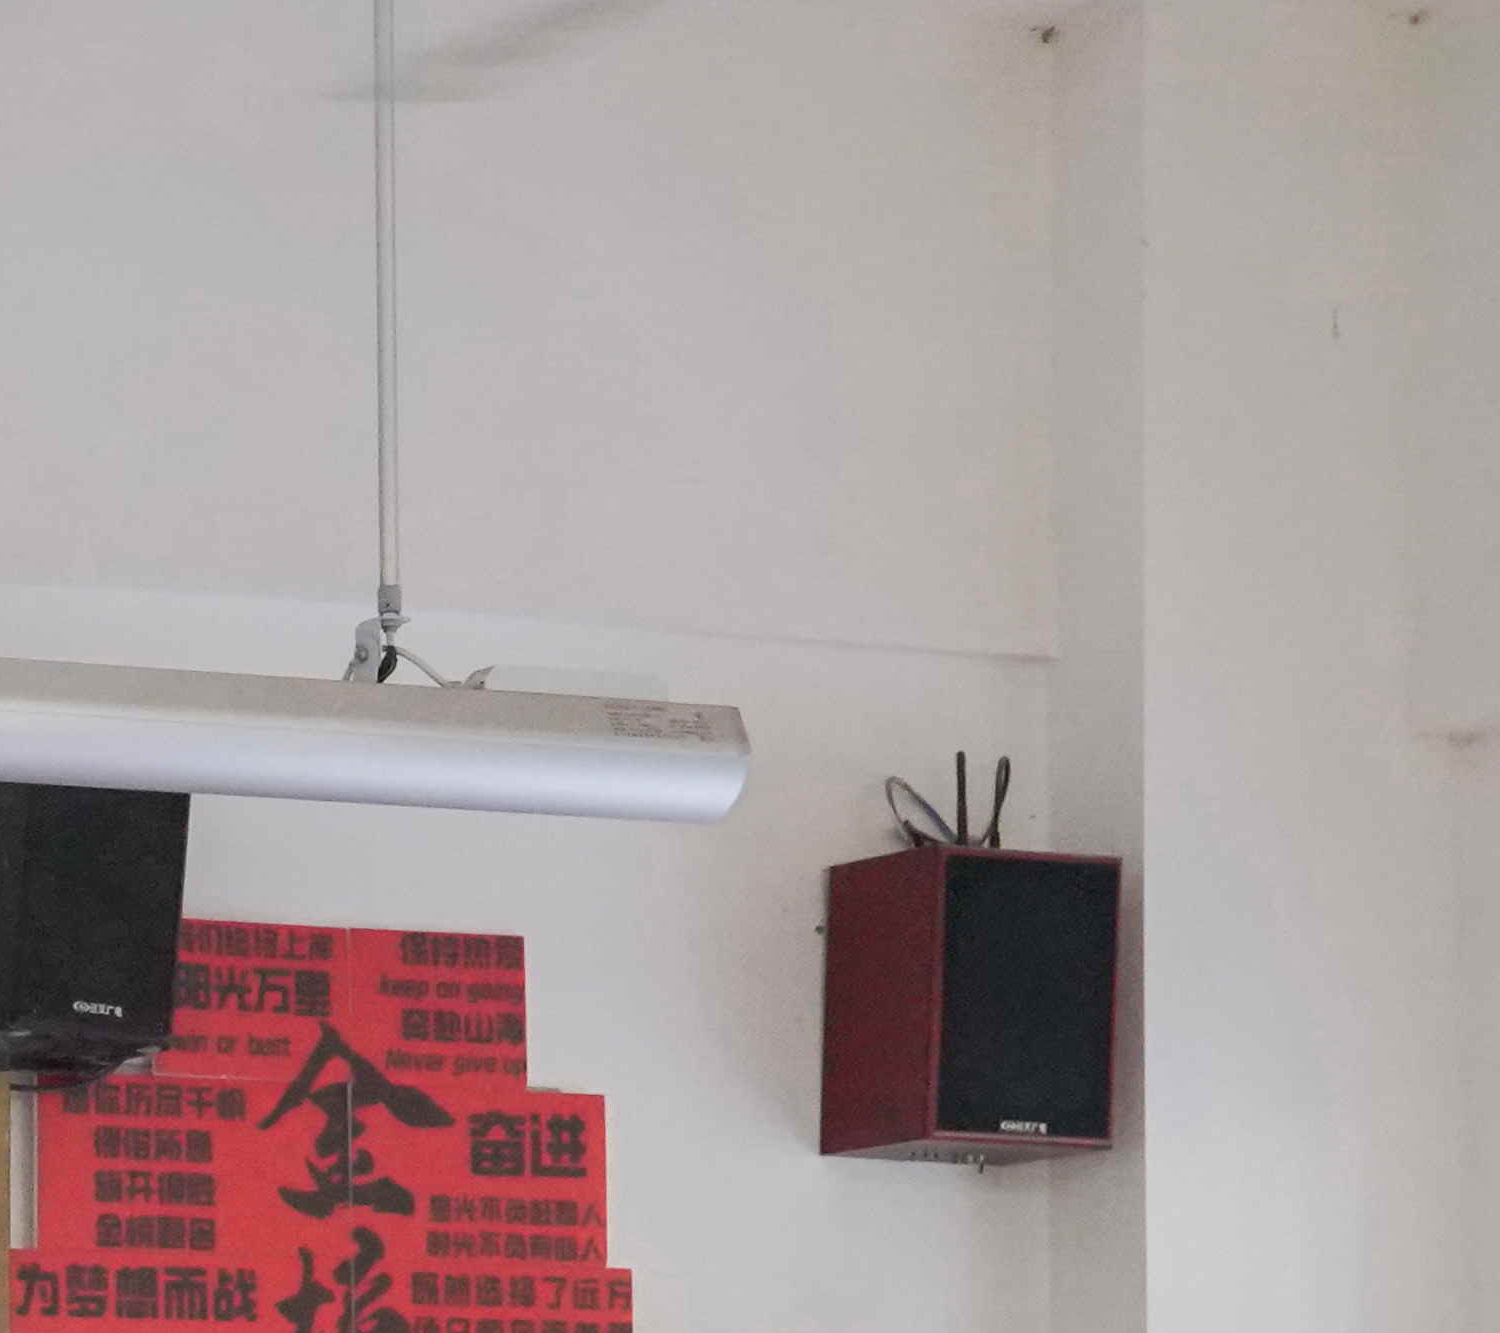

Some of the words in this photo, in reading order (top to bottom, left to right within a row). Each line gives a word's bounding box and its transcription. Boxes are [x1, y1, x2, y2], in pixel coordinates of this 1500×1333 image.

[467, 1110, 587, 1177] 奋进
[94, 1212, 217, 1251] 金榜题名
[15, 1263, 258, 1322] 为梦想而战
[410, 1271, 632, 1310] 既然选择了远方
